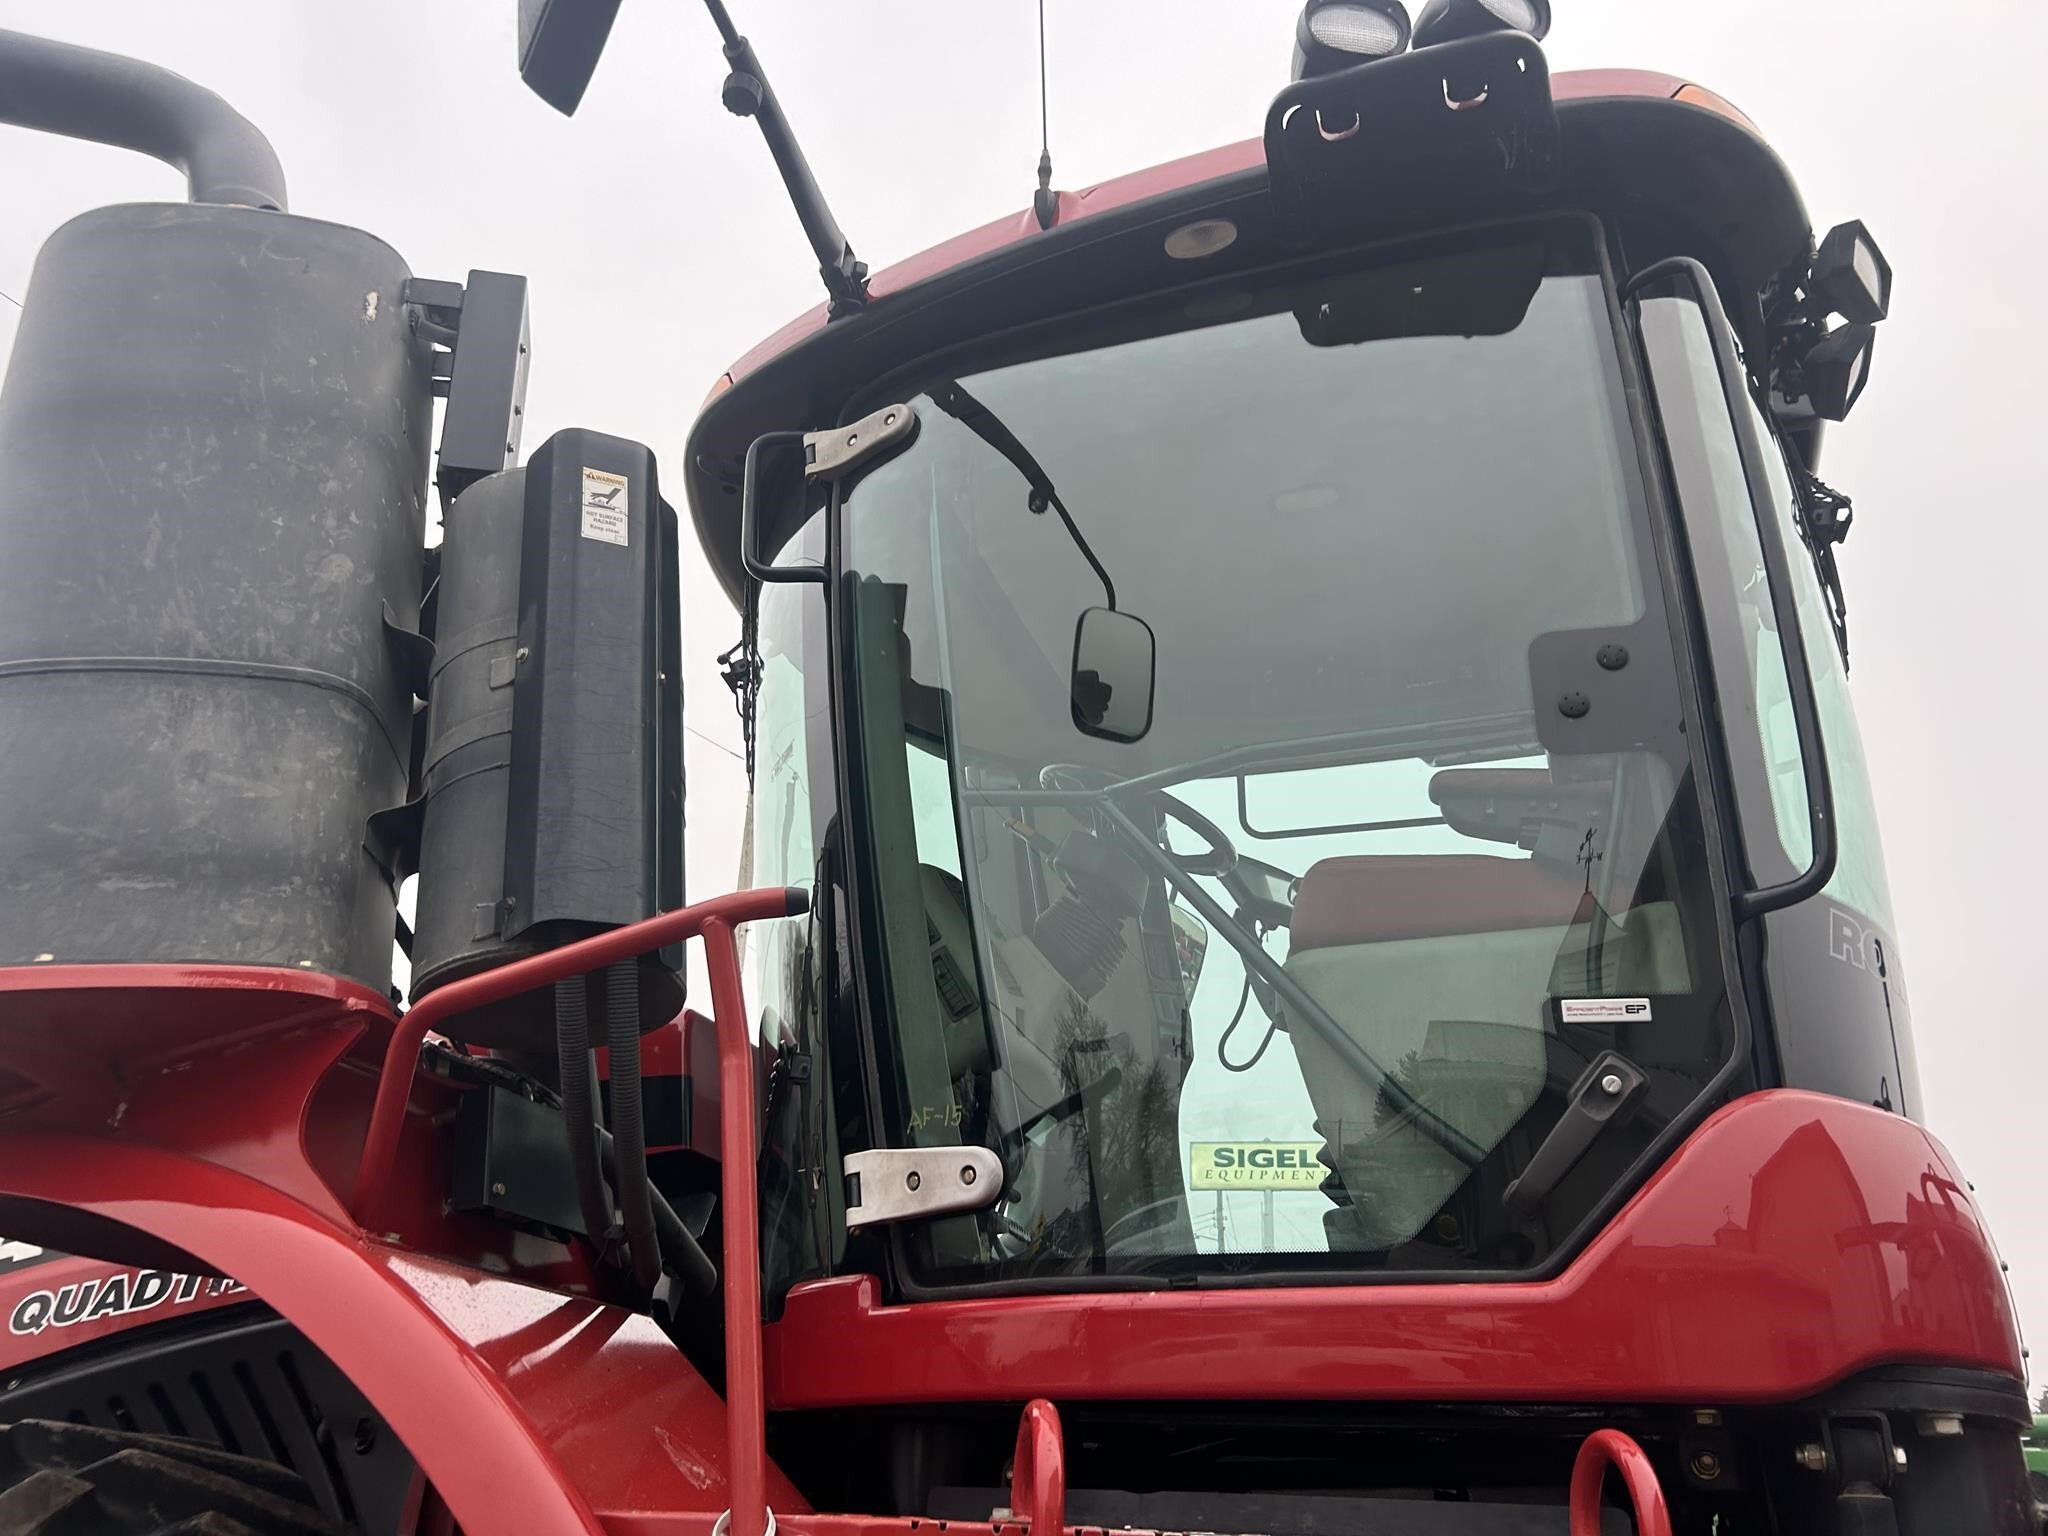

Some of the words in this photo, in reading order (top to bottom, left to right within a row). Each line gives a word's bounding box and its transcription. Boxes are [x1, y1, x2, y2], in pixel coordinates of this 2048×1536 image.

[595, 474, 625, 486] WARNING
[1624, 1004, 1647, 1014] EP
[1213, 1147, 1320, 1168] SIGEL
